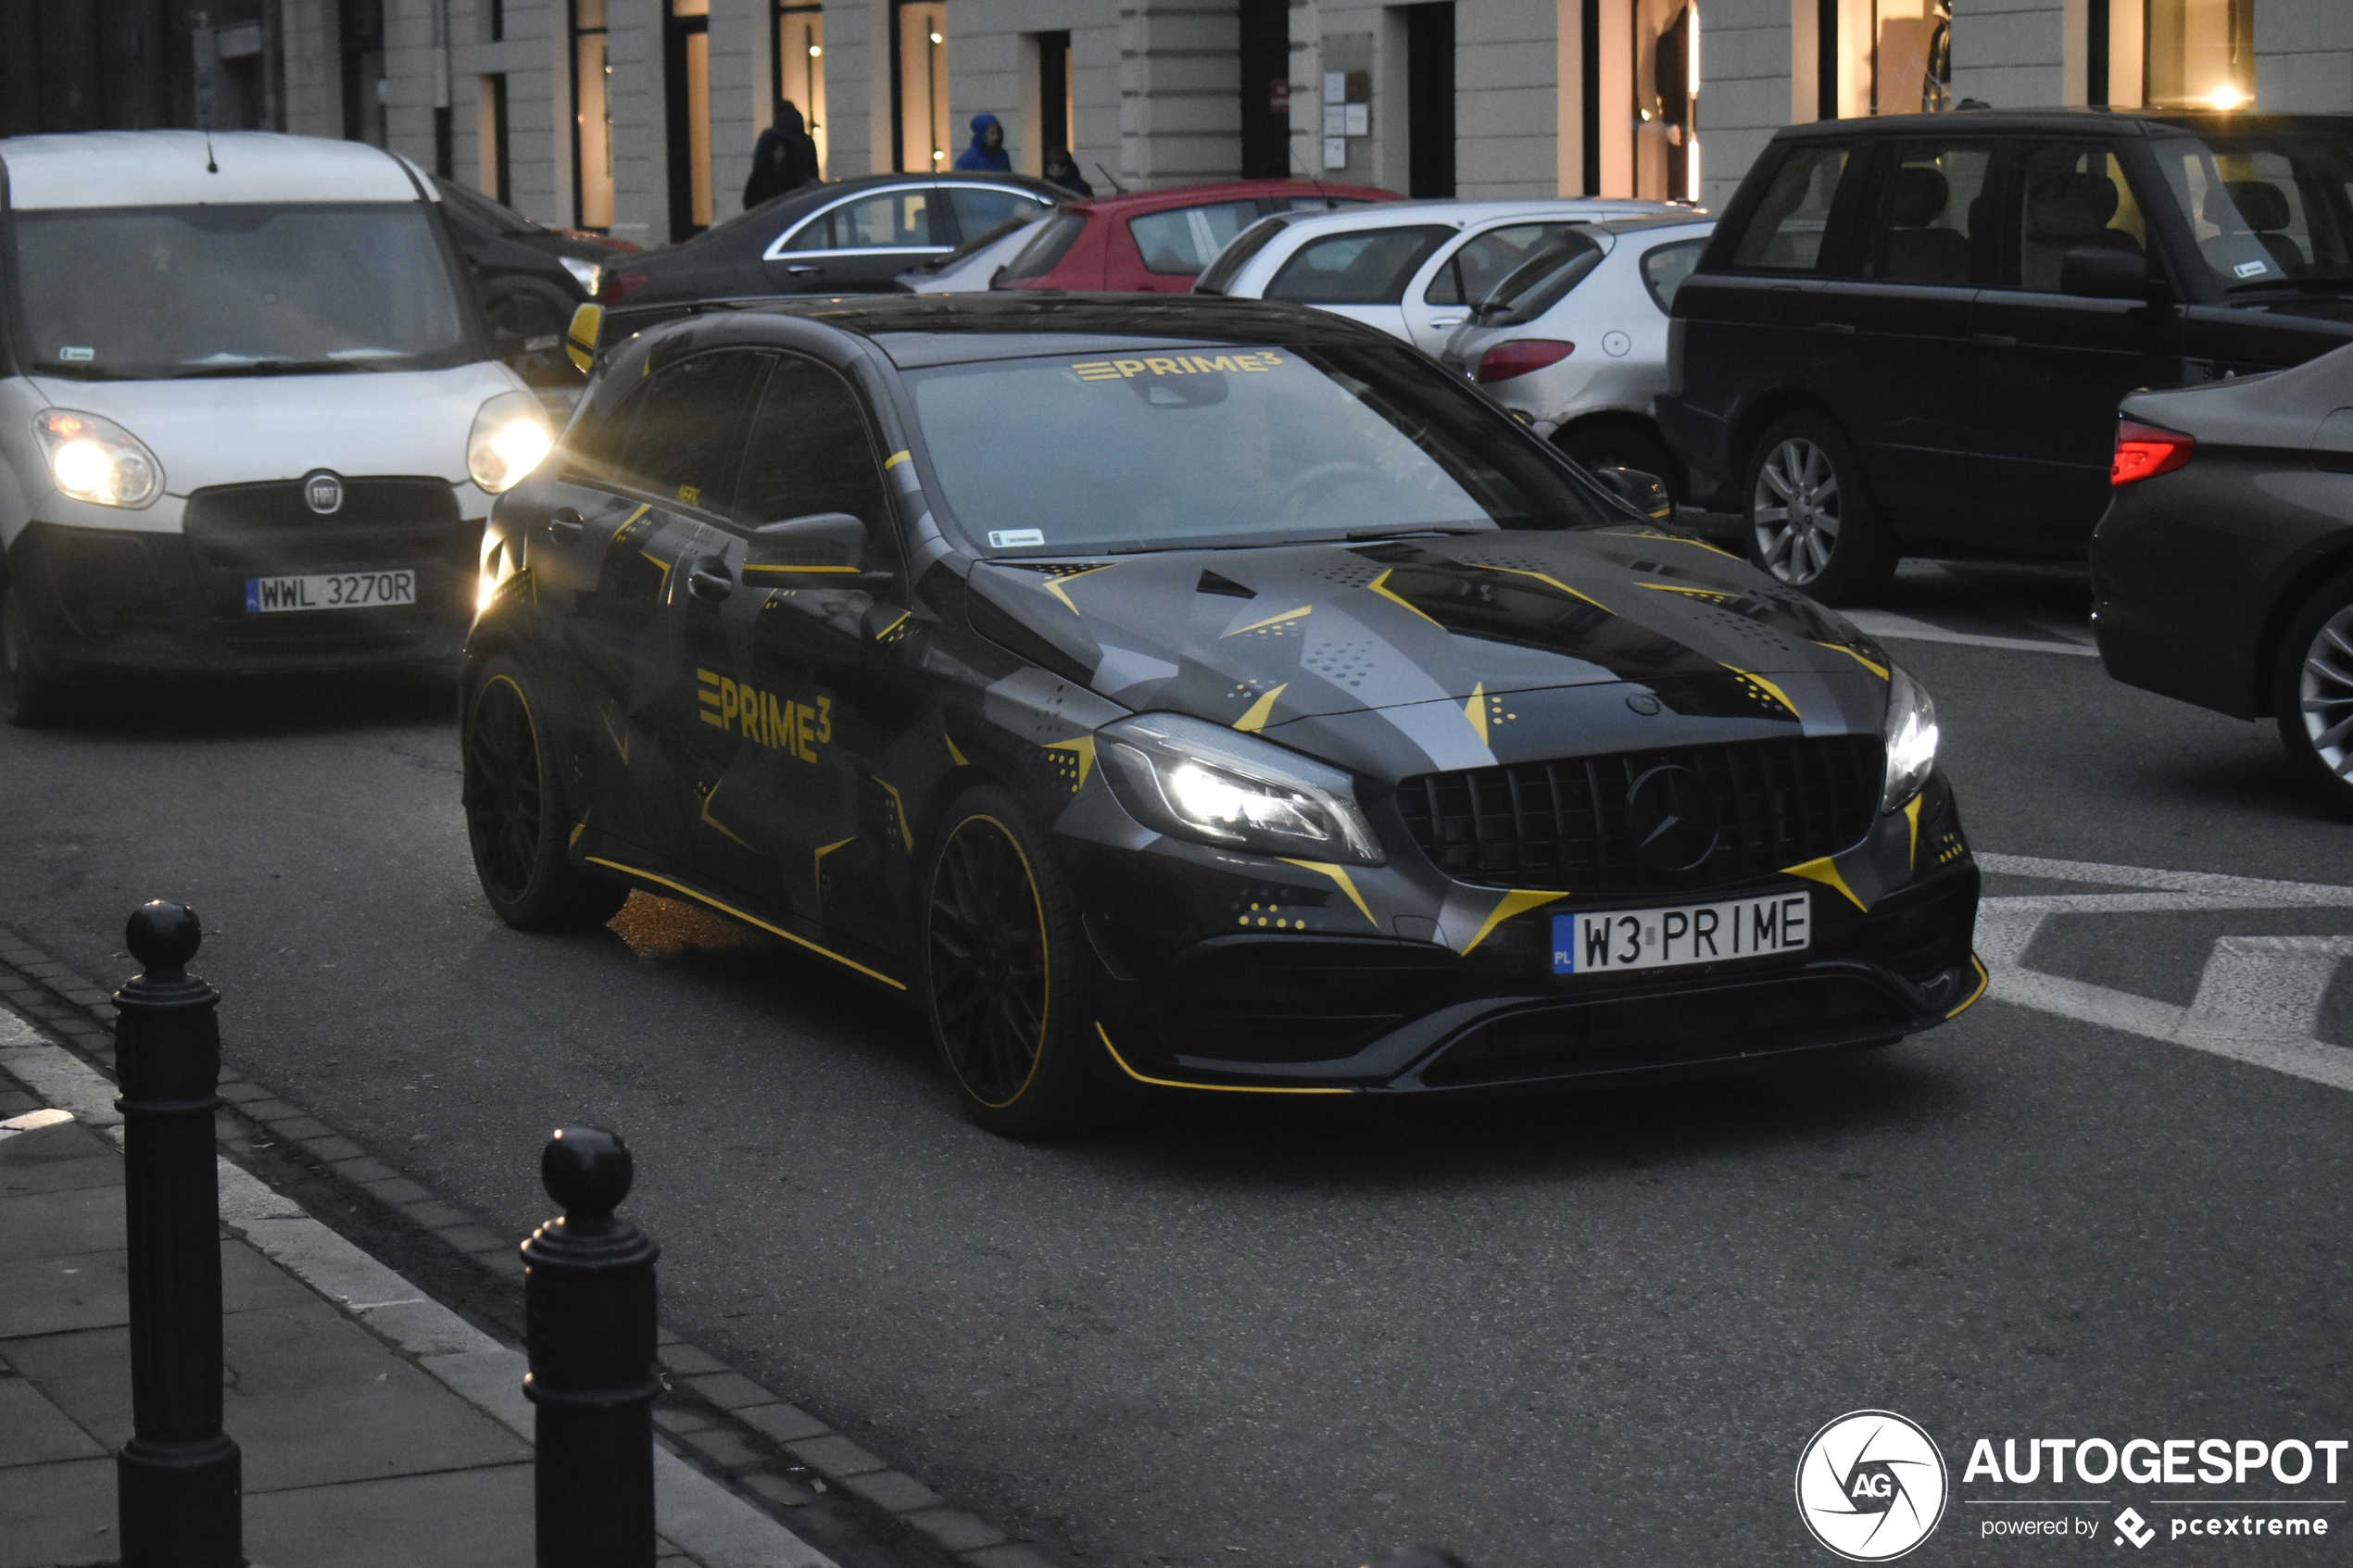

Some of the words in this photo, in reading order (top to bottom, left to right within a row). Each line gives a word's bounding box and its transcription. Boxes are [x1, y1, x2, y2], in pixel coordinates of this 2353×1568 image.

[313, 486, 336, 505] FIAT
[260, 579, 316, 608] WWL
[327, 572, 410, 605] 3270R
[1584, 916, 1641, 967] W3
[1663, 897, 1805, 960] PRIME
[1554, 951, 1571, 964] PL
